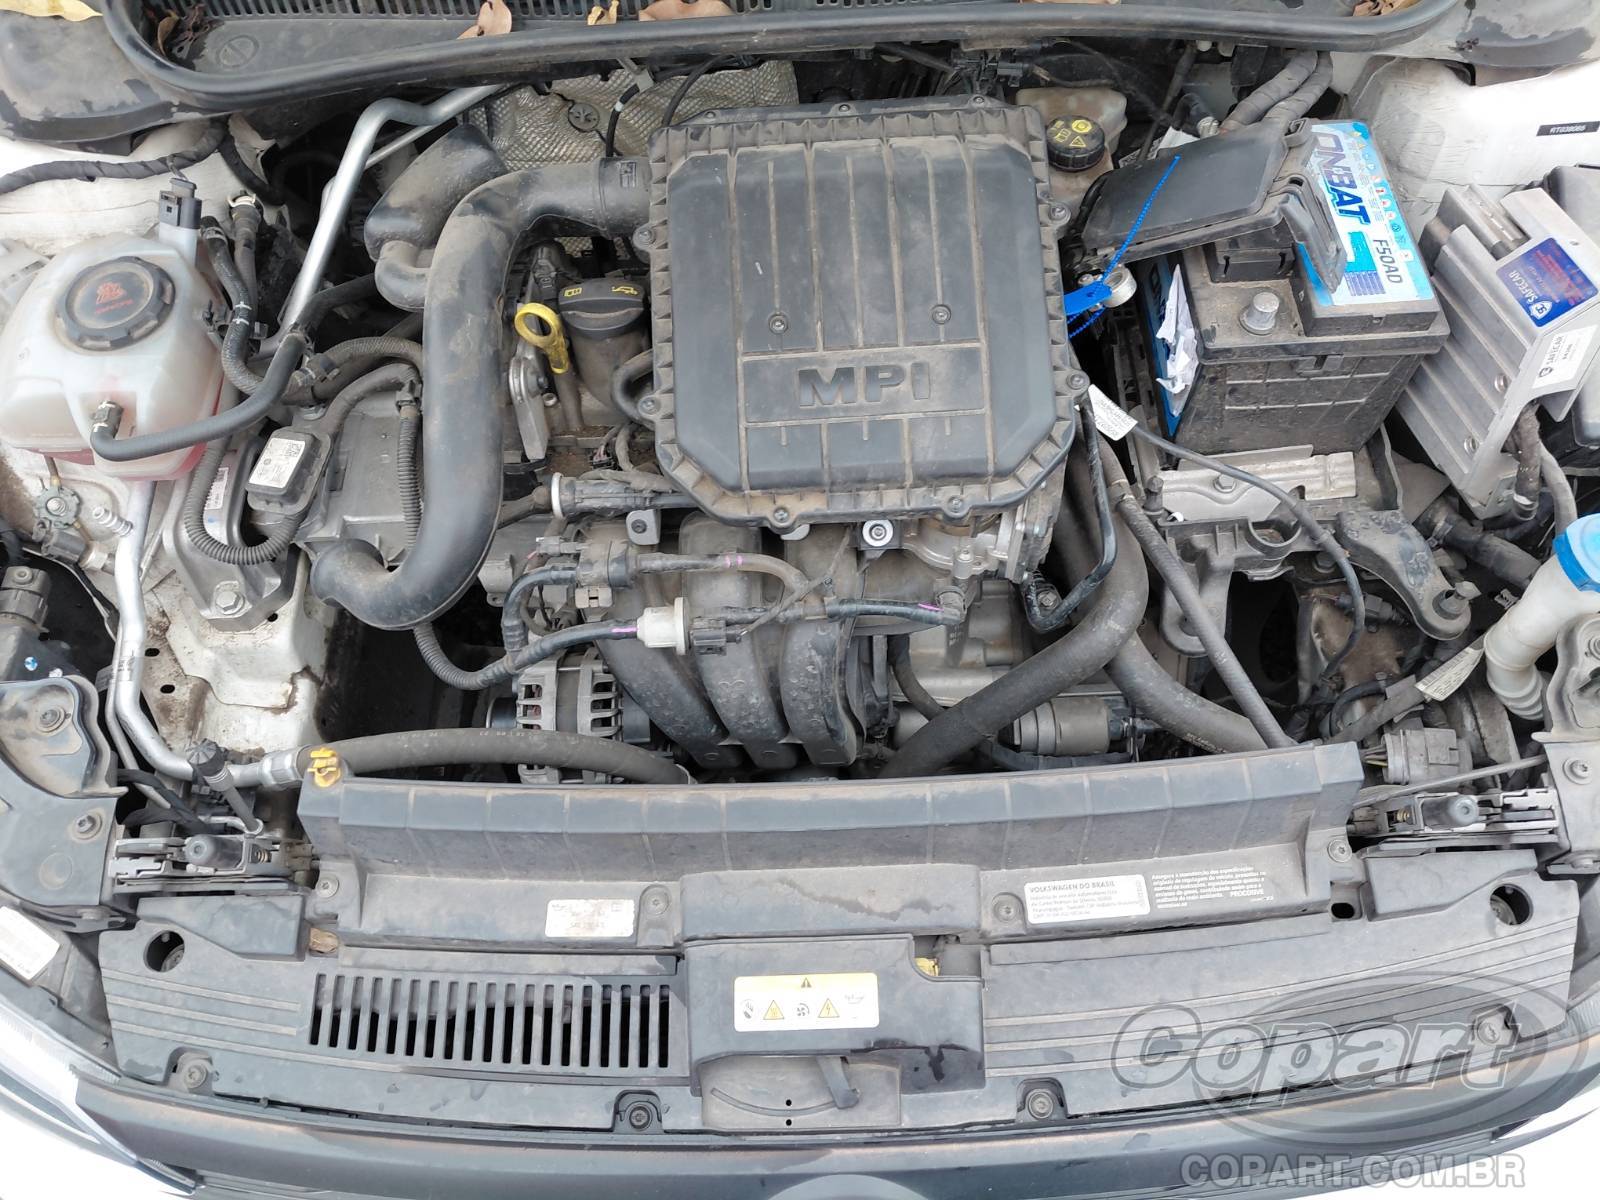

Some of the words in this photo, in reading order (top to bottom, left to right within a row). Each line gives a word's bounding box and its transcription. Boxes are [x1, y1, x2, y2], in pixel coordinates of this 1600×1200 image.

[1373, 239, 1403, 284] F50AD
[1508, 269, 1539, 305] SAFECAR
[798, 361, 931, 406] MPI
[1029, 884, 1079, 894] VOLKSWAGEN
[1079, 882, 1091, 890] DO
[1092, 880, 1116, 889] BRASIL
